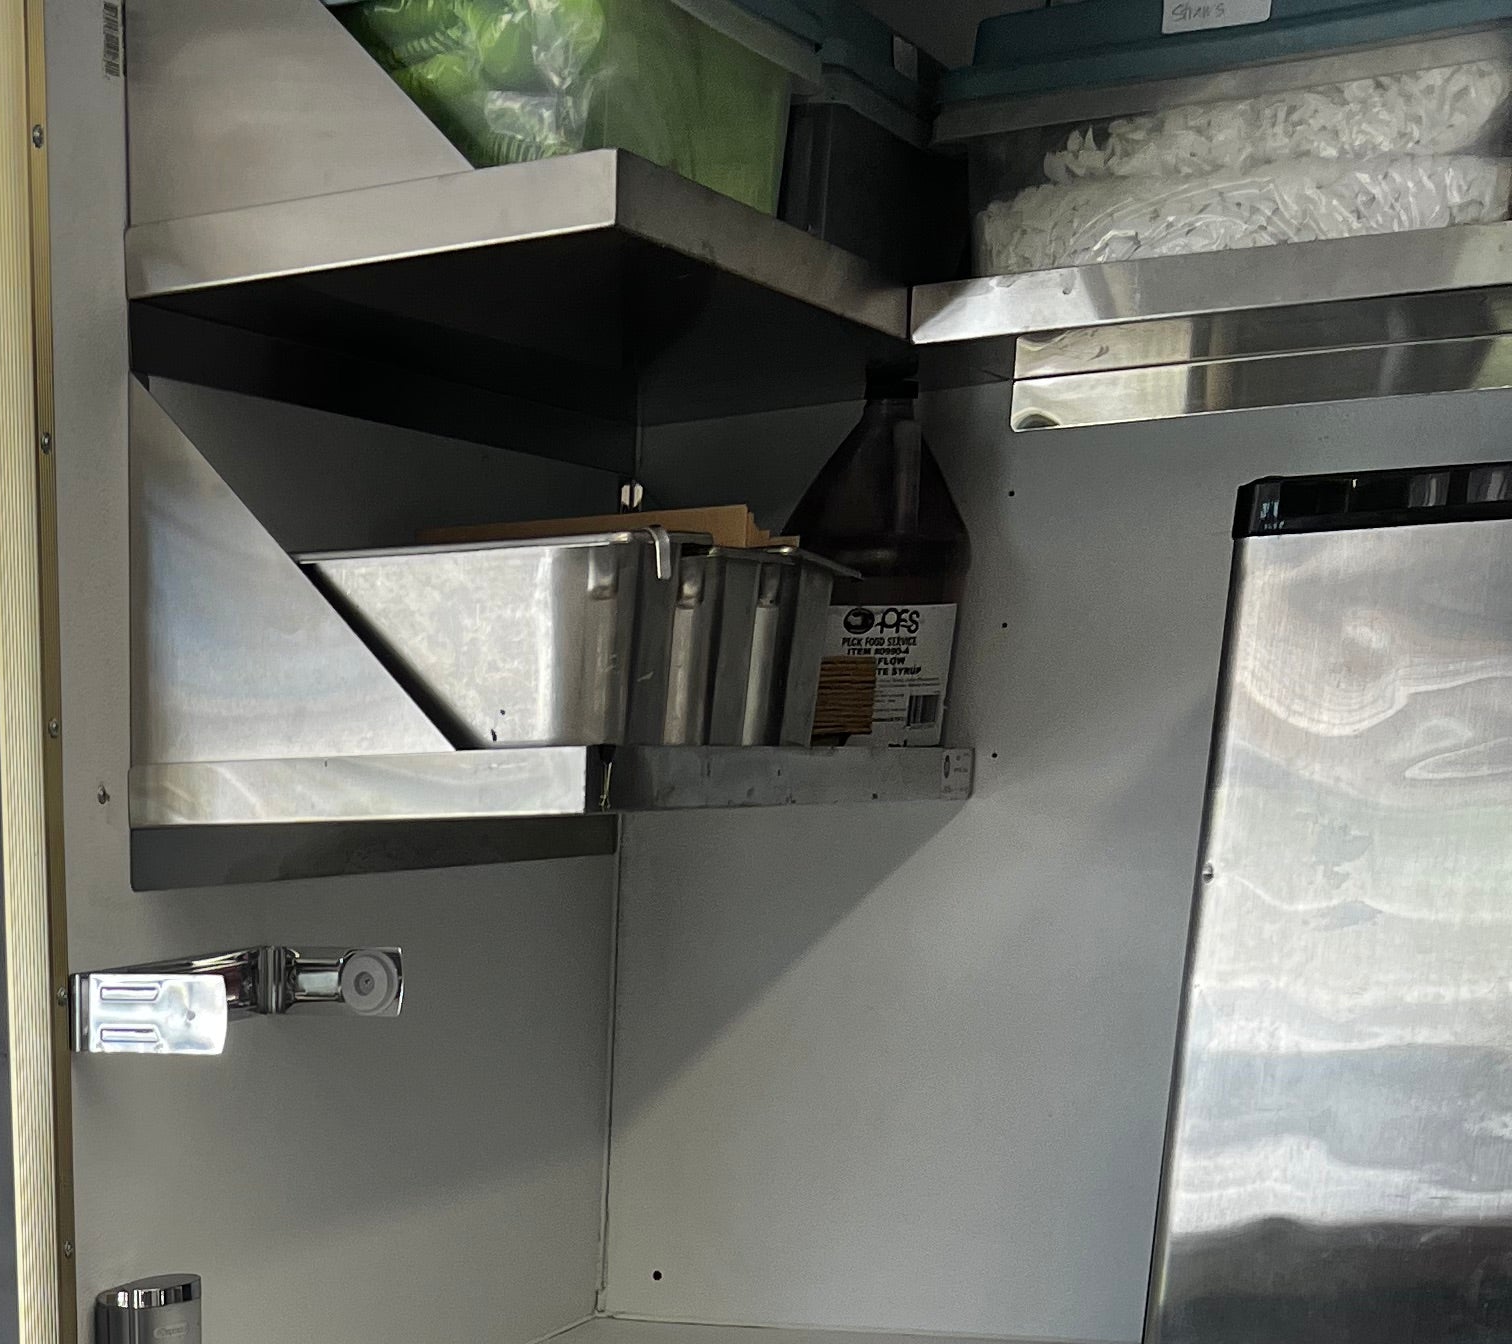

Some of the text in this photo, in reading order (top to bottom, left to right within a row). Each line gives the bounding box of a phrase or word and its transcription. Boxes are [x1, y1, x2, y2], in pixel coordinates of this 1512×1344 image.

[865, 637, 885, 647] FOOD
[887, 636, 918, 646] SERVICE
[848, 648, 872, 656] ITEM
[877, 657, 906, 666] FLOW
[891, 667, 922, 676] SYRUP
